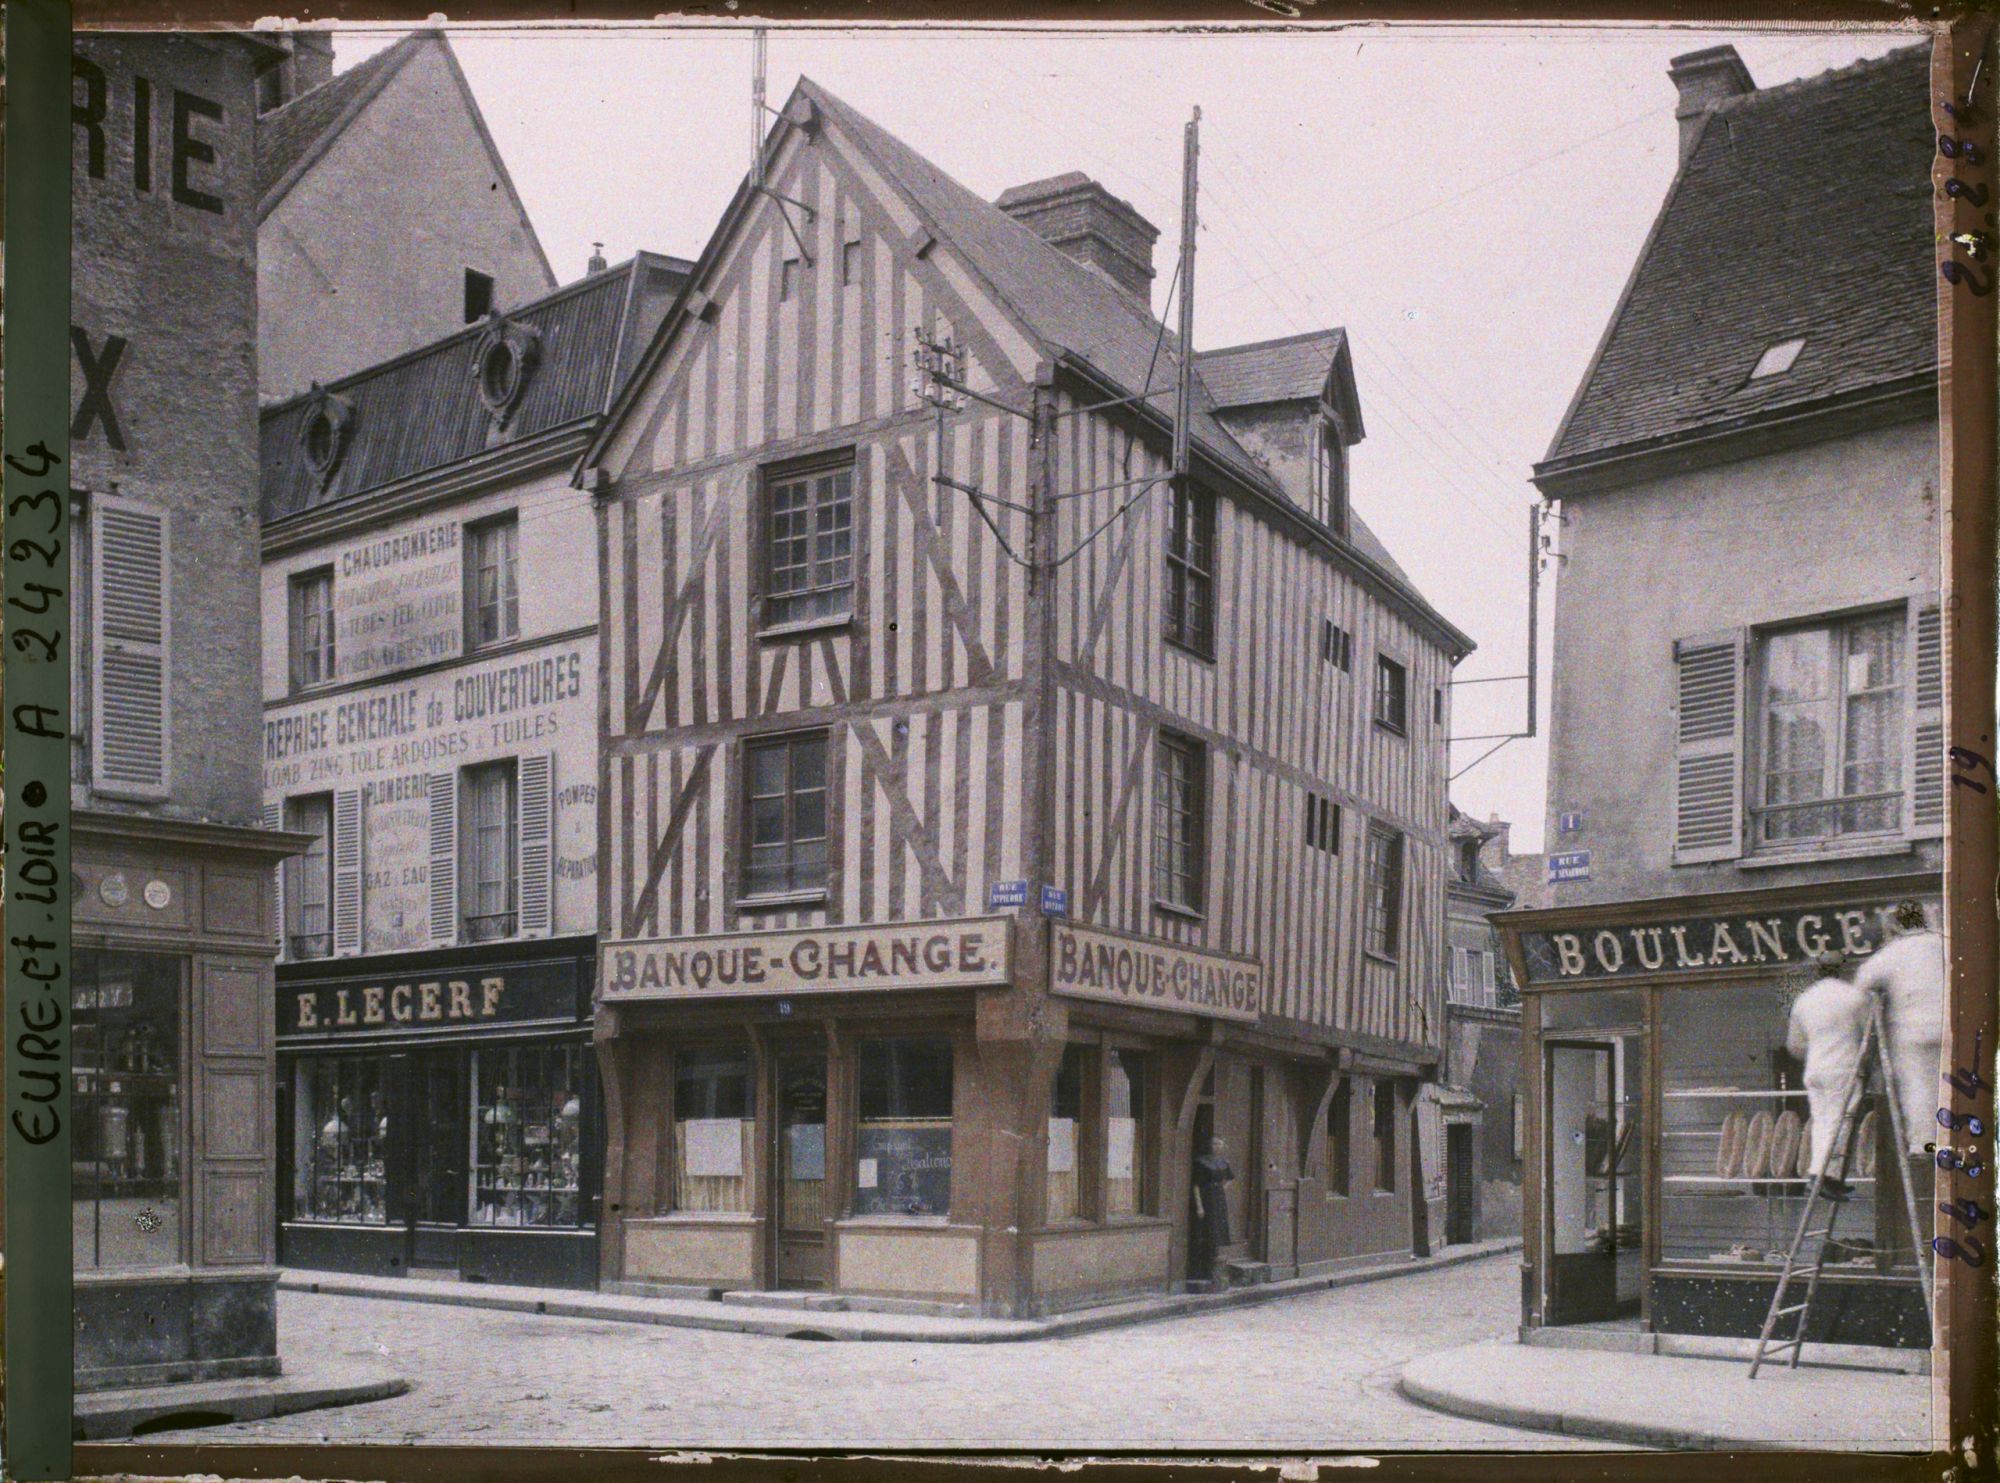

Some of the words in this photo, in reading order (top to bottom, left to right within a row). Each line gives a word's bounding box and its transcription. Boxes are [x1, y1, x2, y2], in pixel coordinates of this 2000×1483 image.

[4, 440, 63, 663] 24234
[343, 522, 457, 576] CHAUDRONNERIE
[427, 692, 443, 728] de
[454, 652, 580, 721] COUVERTURES
[389, 730, 468, 768] ARDOISES
[491, 712, 558, 746] TUILES
[558, 785, 597, 810] POMPES
[367, 870, 391, 890] GAZ
[402, 866, 428, 886] EAU
[1553, 901, 1938, 975] BOULANGE
